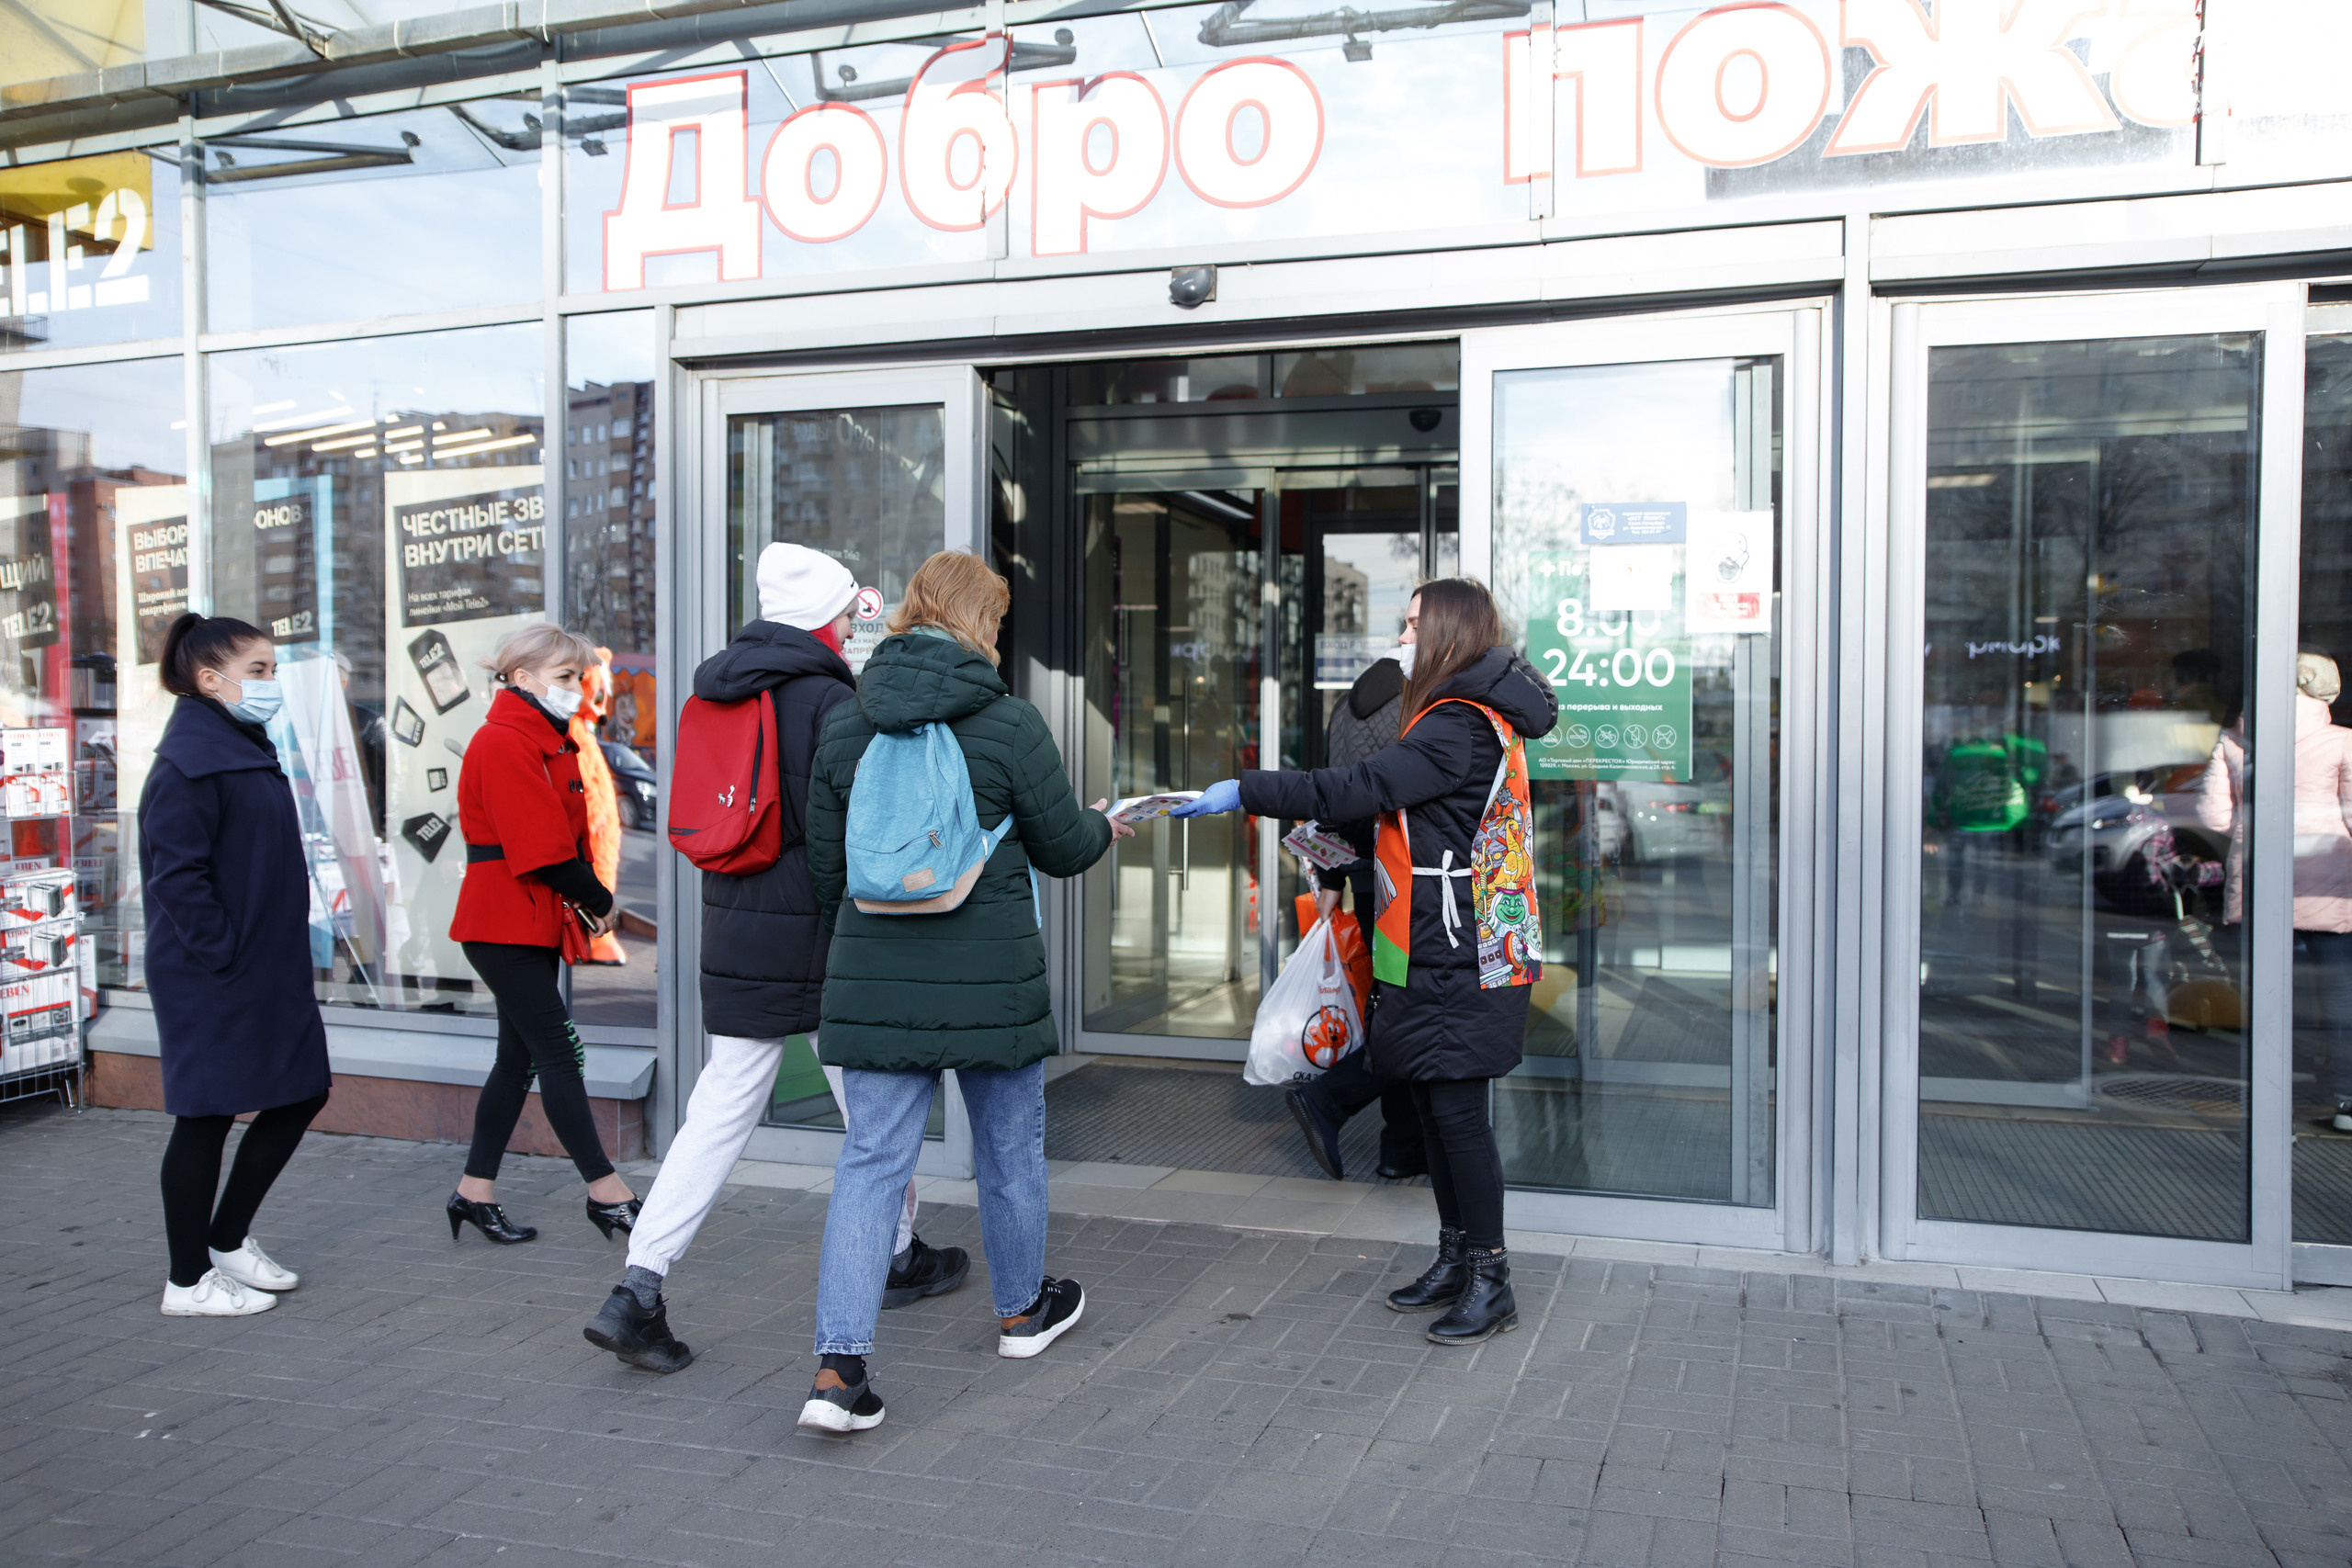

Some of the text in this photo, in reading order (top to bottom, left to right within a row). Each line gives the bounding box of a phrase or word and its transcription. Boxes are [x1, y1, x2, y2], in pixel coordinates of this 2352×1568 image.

[602, 31, 1325, 293] Добро
[401, 501, 509, 537] ЧЕСТНЫЕ
[133, 525, 187, 551] ВЫБОР
[404, 533, 493, 568] ВНУТРИ
[408, 586, 472, 603] На всех тарифах
[3, 601, 53, 640] TELE2
[271, 610, 313, 637] TELE2
[1556, 598, 1662, 637] 8.00
[419, 641, 447, 669] TELE2
[1542, 648, 1676, 688] 24:00
[1566, 704, 1611, 713] перерыва
[1620, 704, 1663, 713] выходных
[416, 817, 446, 842] TELE2
